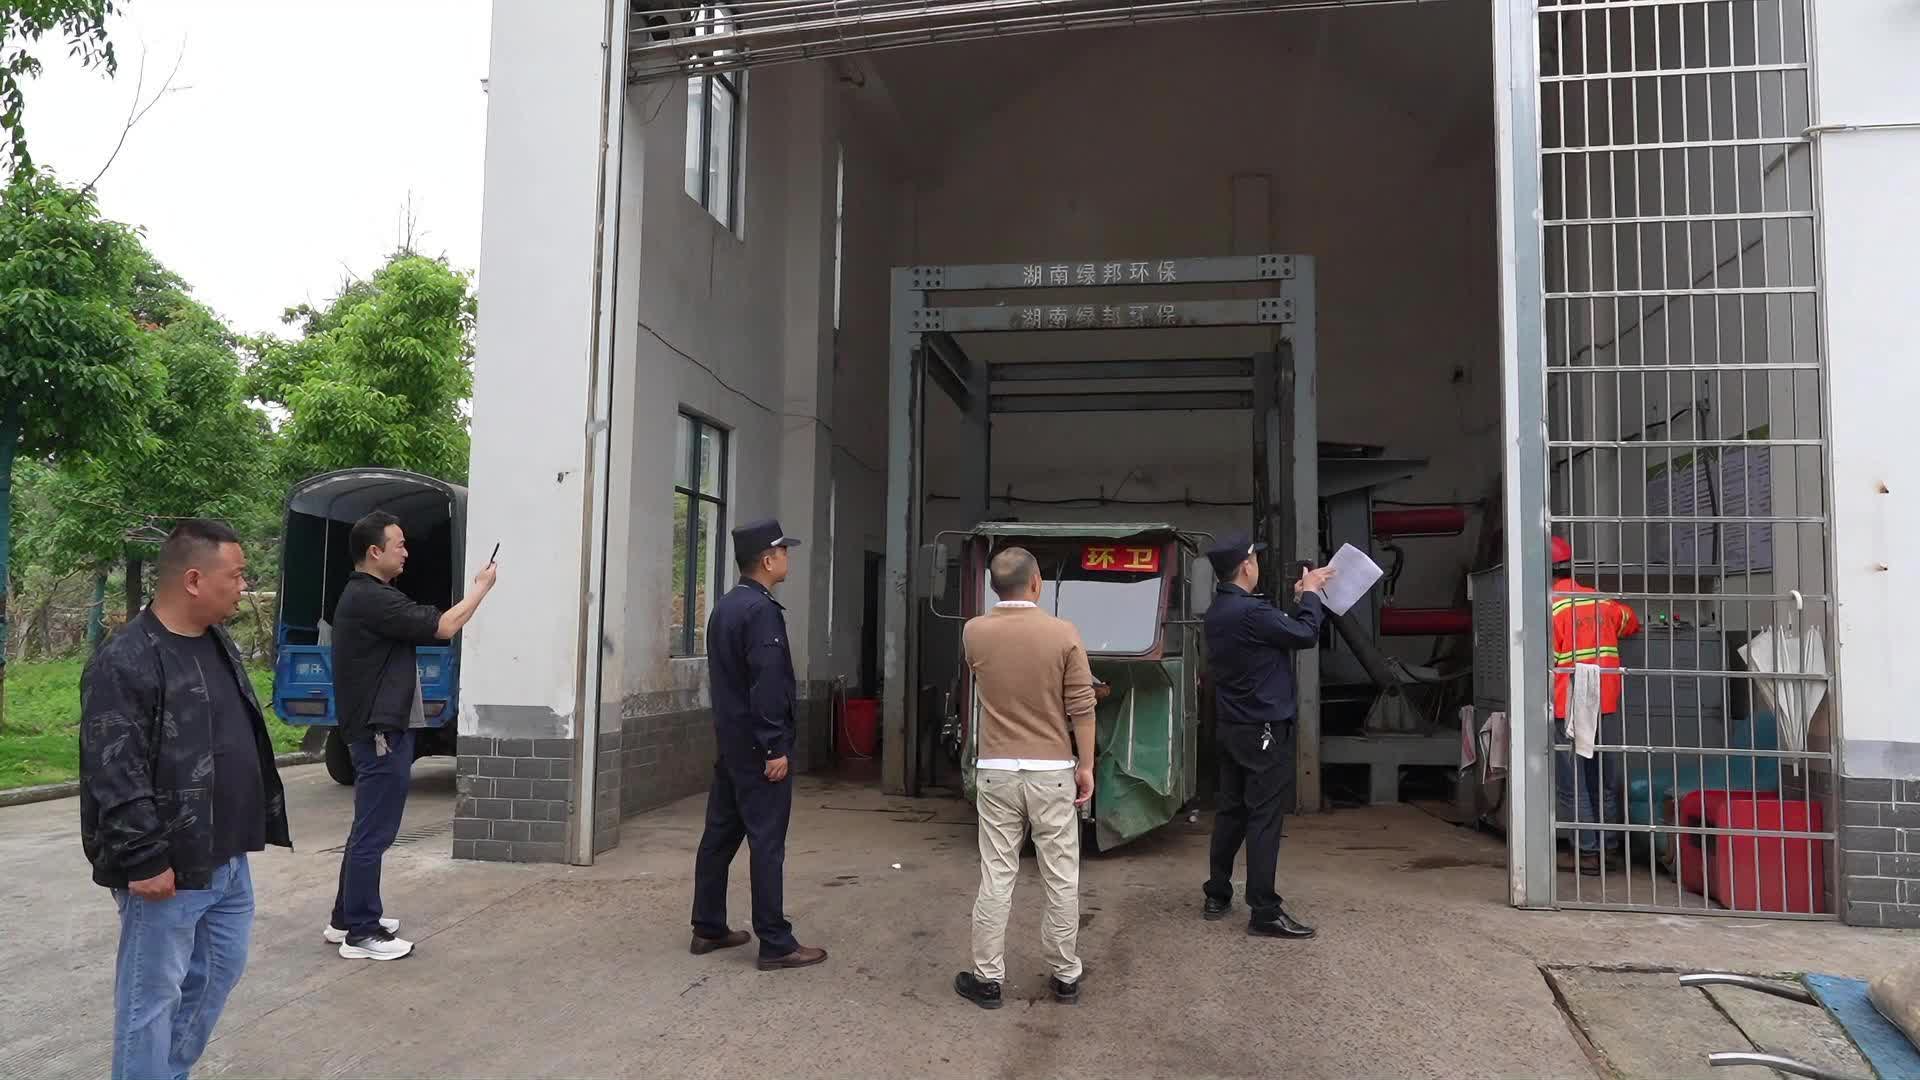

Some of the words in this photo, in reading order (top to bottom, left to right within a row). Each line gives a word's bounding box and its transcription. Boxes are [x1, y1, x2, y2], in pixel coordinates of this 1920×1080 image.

[1023, 260, 1177, 286] 湖南绿邦环保
[1087, 547, 1153, 569] 环卫
